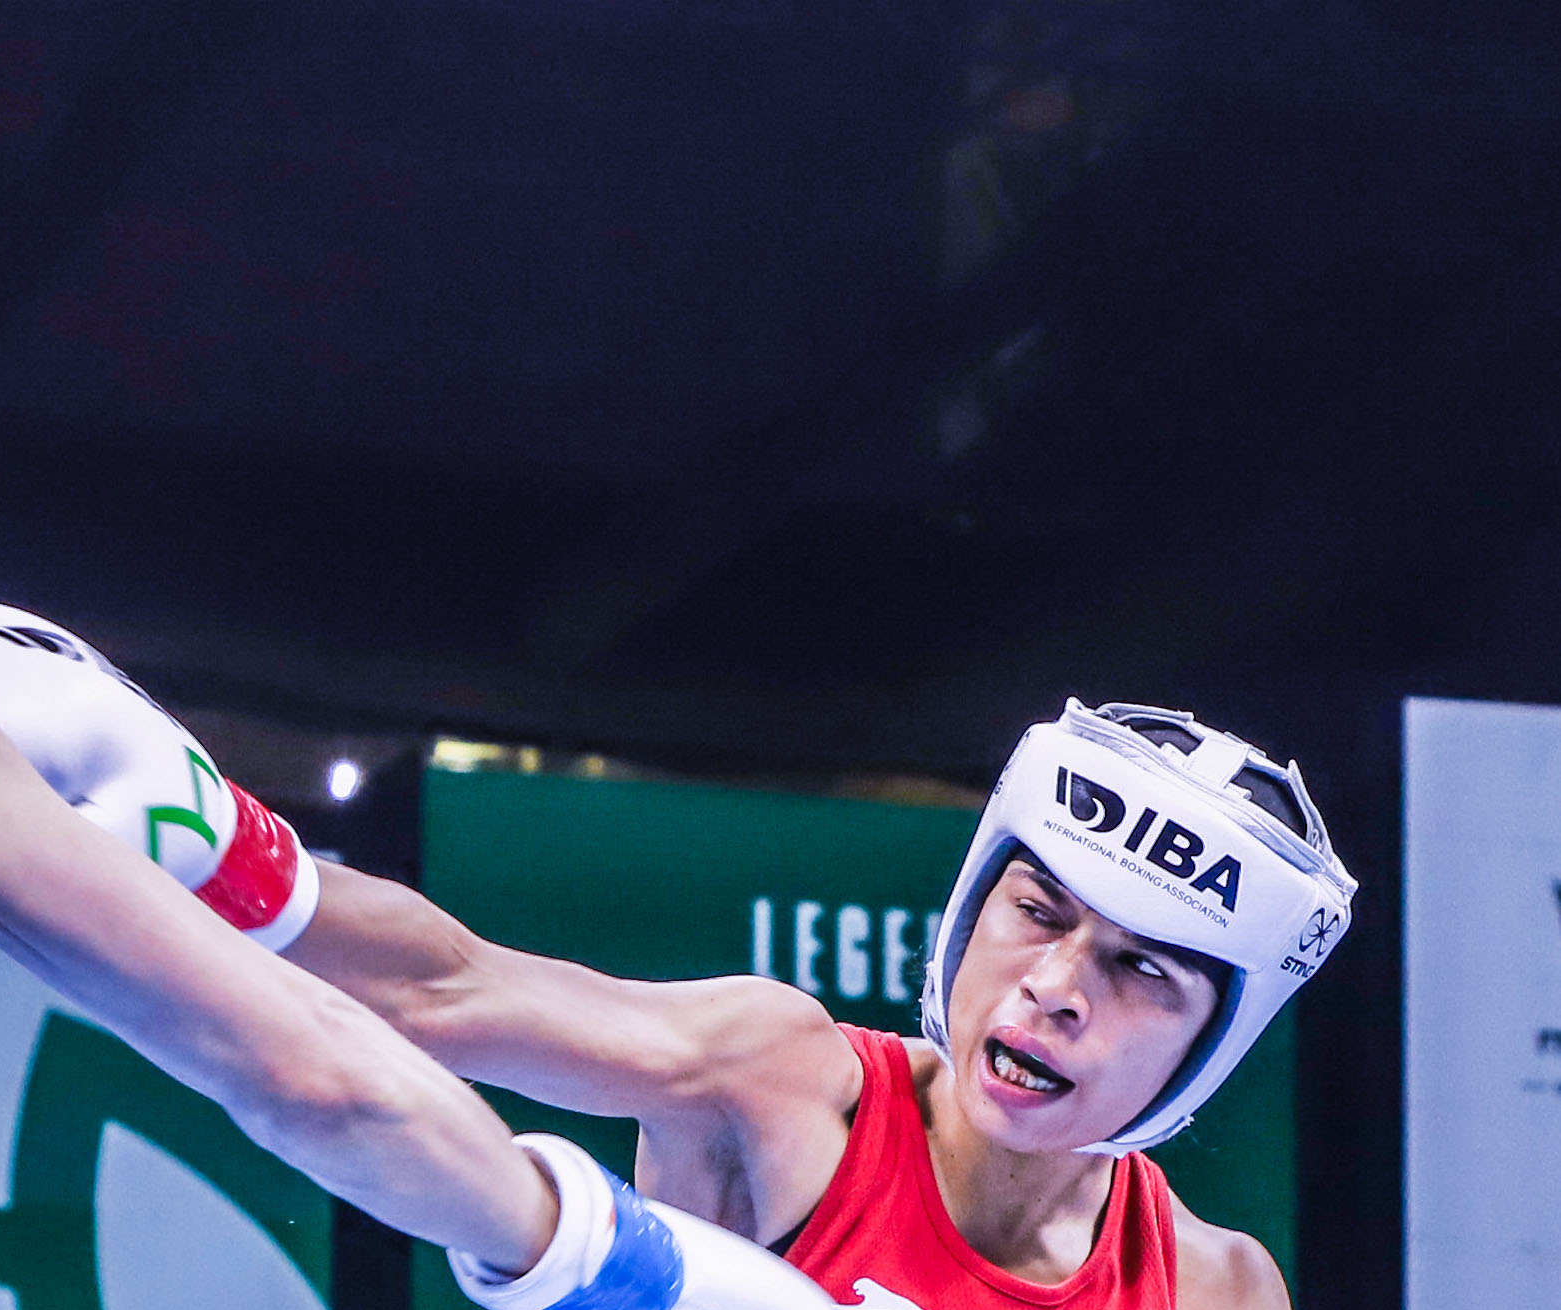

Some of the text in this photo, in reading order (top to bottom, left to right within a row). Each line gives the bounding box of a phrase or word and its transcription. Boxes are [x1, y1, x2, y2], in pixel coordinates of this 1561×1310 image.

[1043, 819, 1230, 930] INTERNATIONAL BOXING ASSOCIATION
[1123, 806, 1242, 914] IBA
